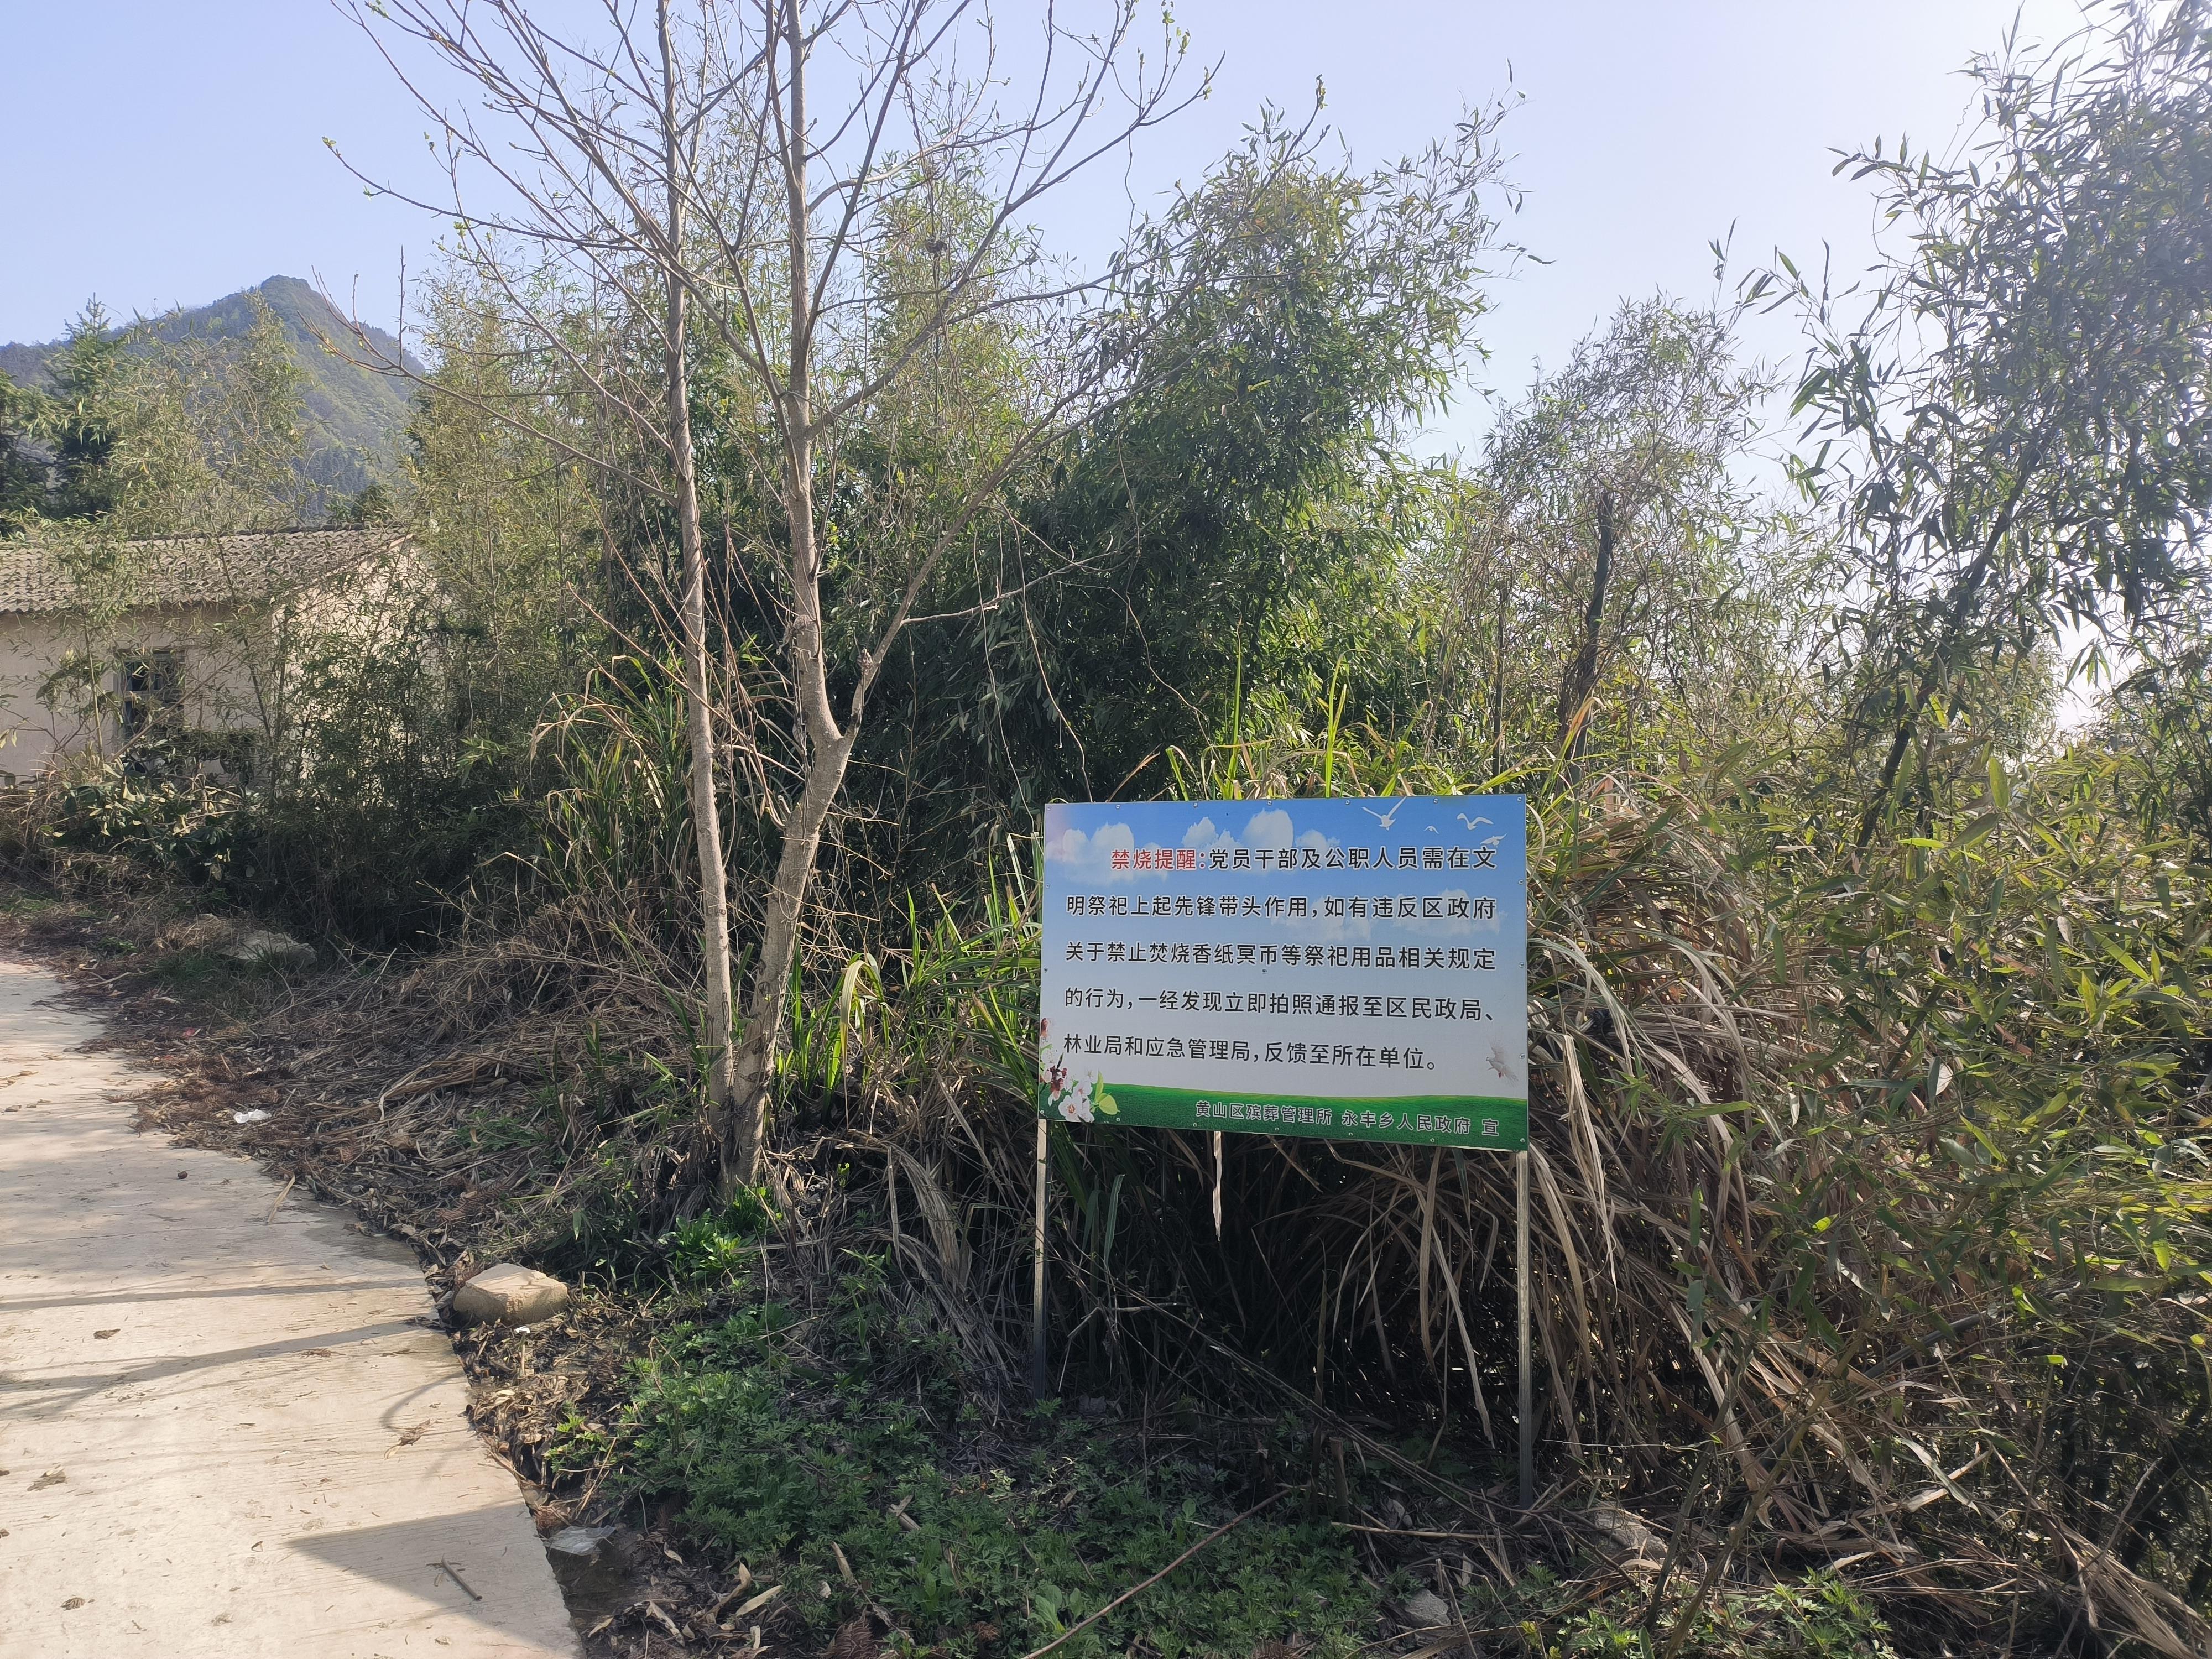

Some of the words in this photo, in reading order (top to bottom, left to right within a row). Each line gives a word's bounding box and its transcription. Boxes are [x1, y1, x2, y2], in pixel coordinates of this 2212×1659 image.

[1111, 846, 1496, 870] 禁烧提醒：党员干部及公职人员需在文
[1067, 895, 1495, 919] 明祭祀上起先锋带头作用，如有违反区政府
[1065, 941, 1496, 970] 关于禁止焚烧香纸冥币等祭祀用品相关规定
[1065, 987, 1493, 1021] 的行为，一经发现立即拍照通报至区民政局、
[1063, 1033, 1435, 1070] 林业局和应急管理局，反馈至所在单位。
[1196, 1101, 1332, 1125] 黄山区殡葬管理所
[1342, 1110, 1470, 1134] 永丰乡人民政府
[1482, 1119, 1499, 1136] 宣
